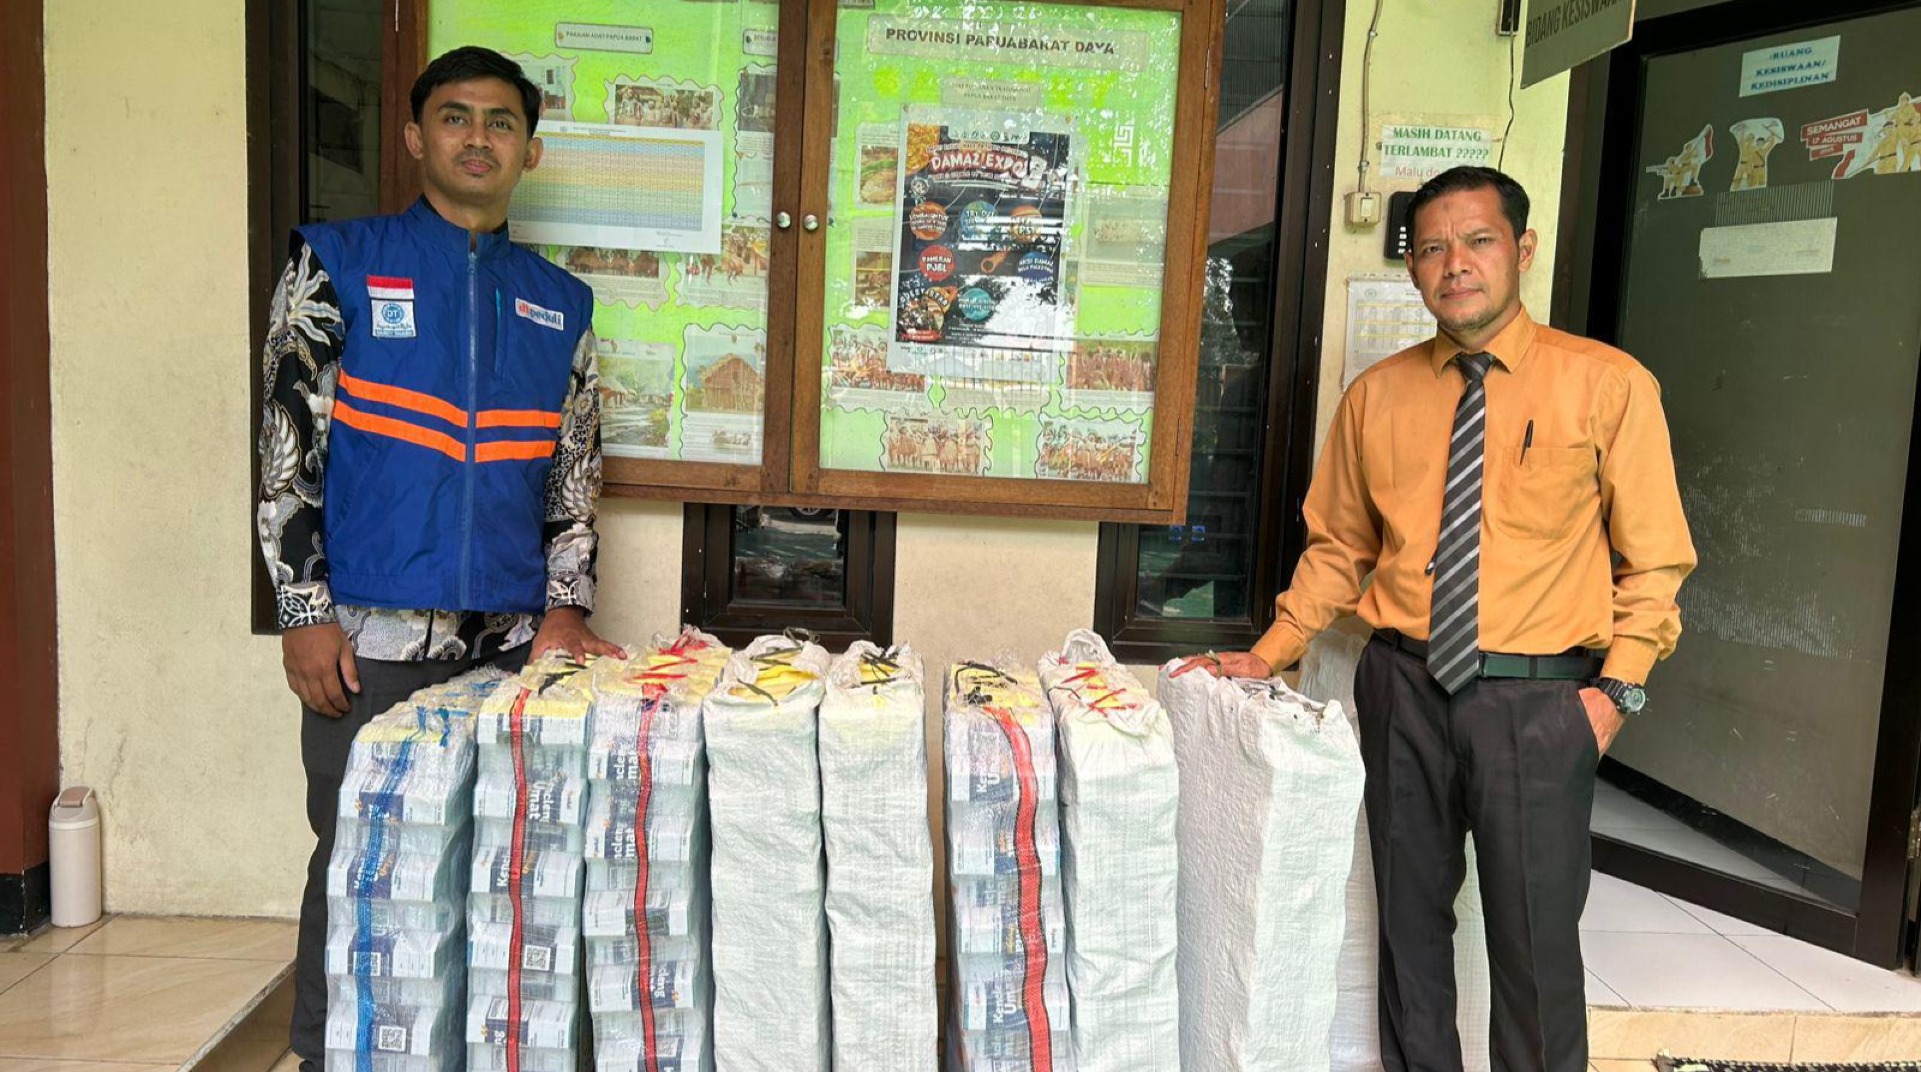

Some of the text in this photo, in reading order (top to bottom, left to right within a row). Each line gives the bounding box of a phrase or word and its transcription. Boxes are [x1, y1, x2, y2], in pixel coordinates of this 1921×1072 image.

[1562, 0, 1618, 30] KESISW
[885, 28, 960, 44] PROVINSI
[1074, 41, 1115, 54] DAYA
[1770, 47, 1813, 60] RUANG
[1750, 72, 1830, 90] KEDISIPLINAN
[1806, 116, 1862, 134] SEMANGAT
[1393, 127, 1482, 141] MASIH DATANG
[1821, 134, 1858, 144] AGUSTUS
[1384, 145, 1452, 158] TERLAMBAT
[1395, 166, 1424, 177] Malu
